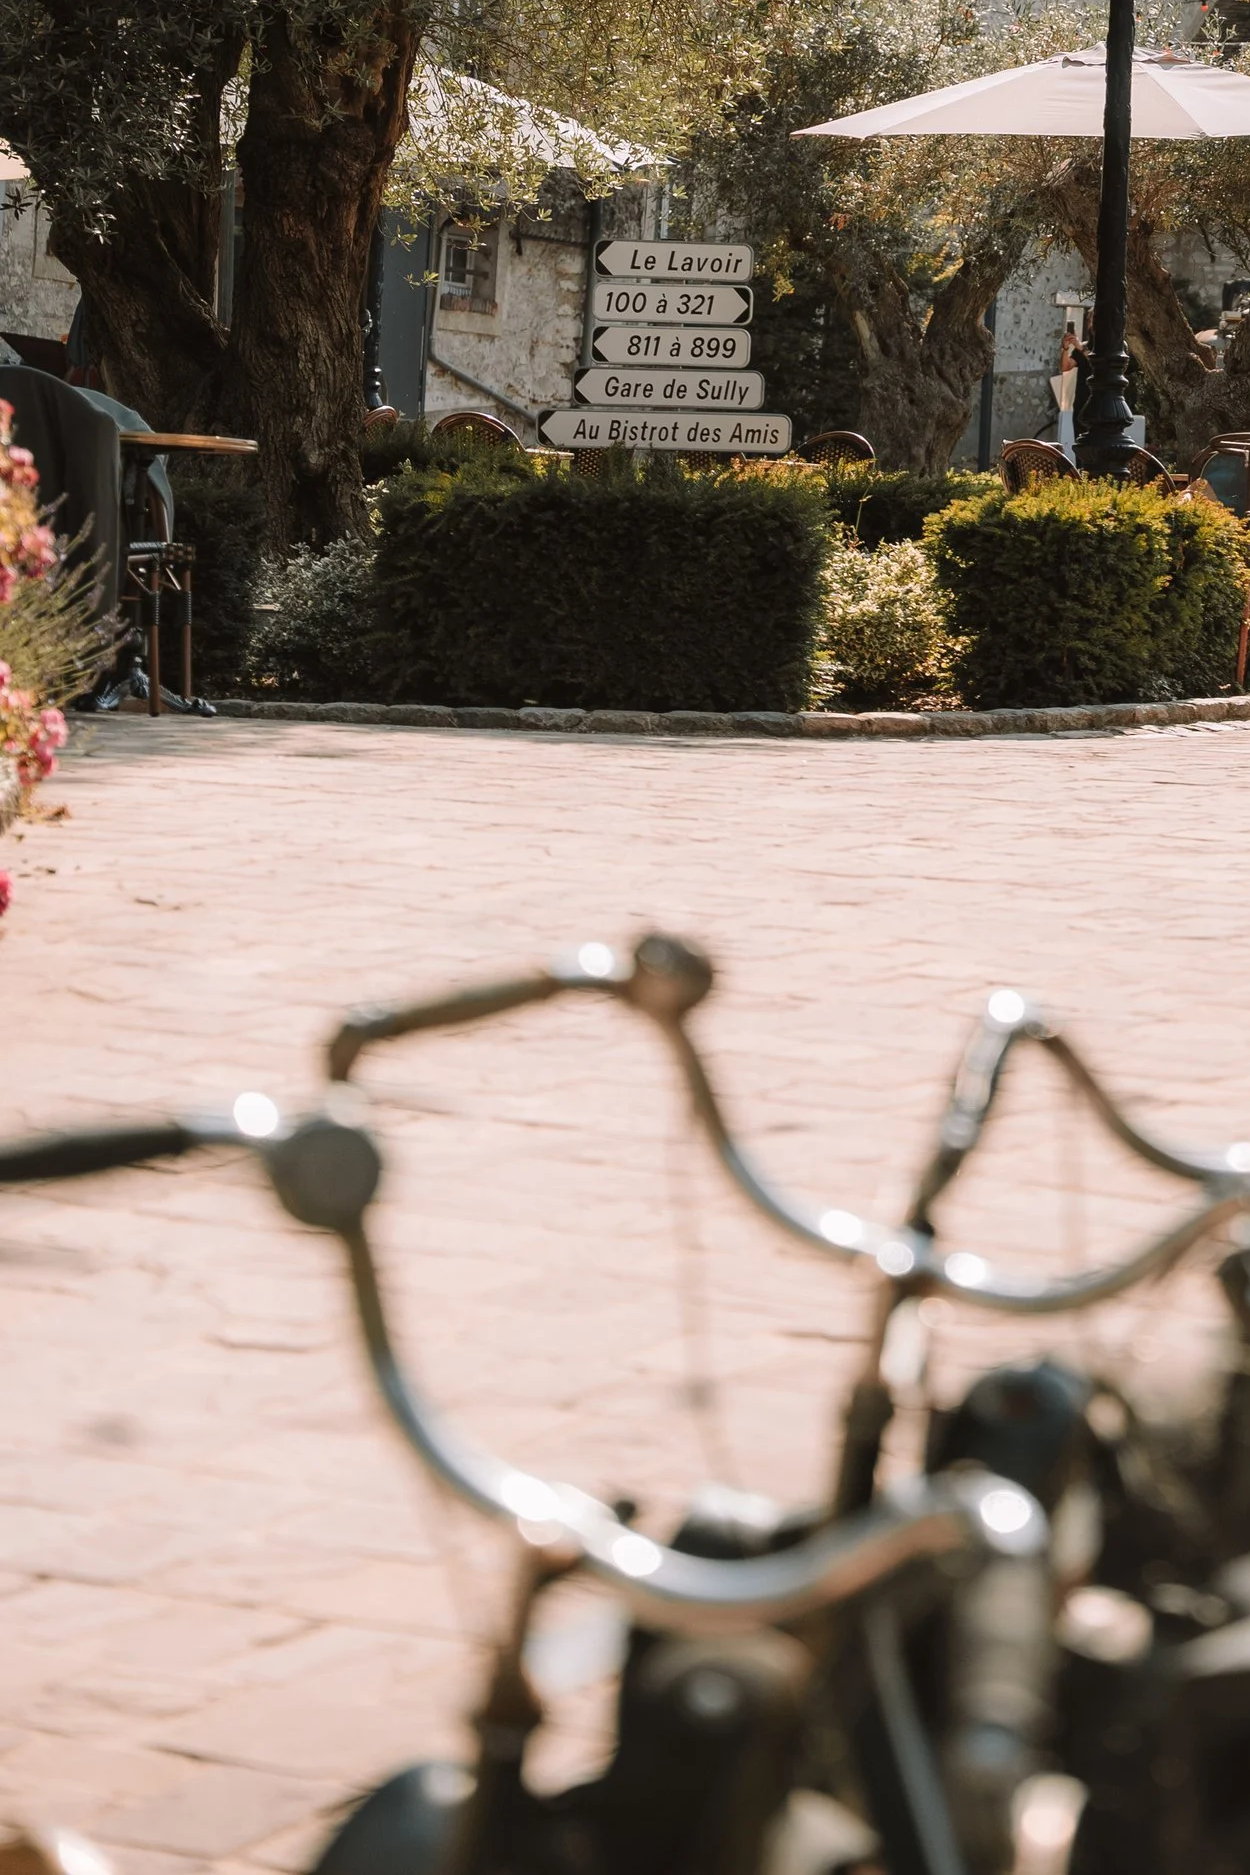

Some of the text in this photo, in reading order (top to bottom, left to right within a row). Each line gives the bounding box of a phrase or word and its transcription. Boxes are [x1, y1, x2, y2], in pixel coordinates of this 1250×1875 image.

[630, 249, 743, 274] Le Lavoir
[605, 291, 715, 316] 100 à 321
[627, 334, 737, 359] 811 à 899
[604, 376, 750, 406] Gare de Sully
[572, 418, 780, 445] Au Bistrot des Amis
